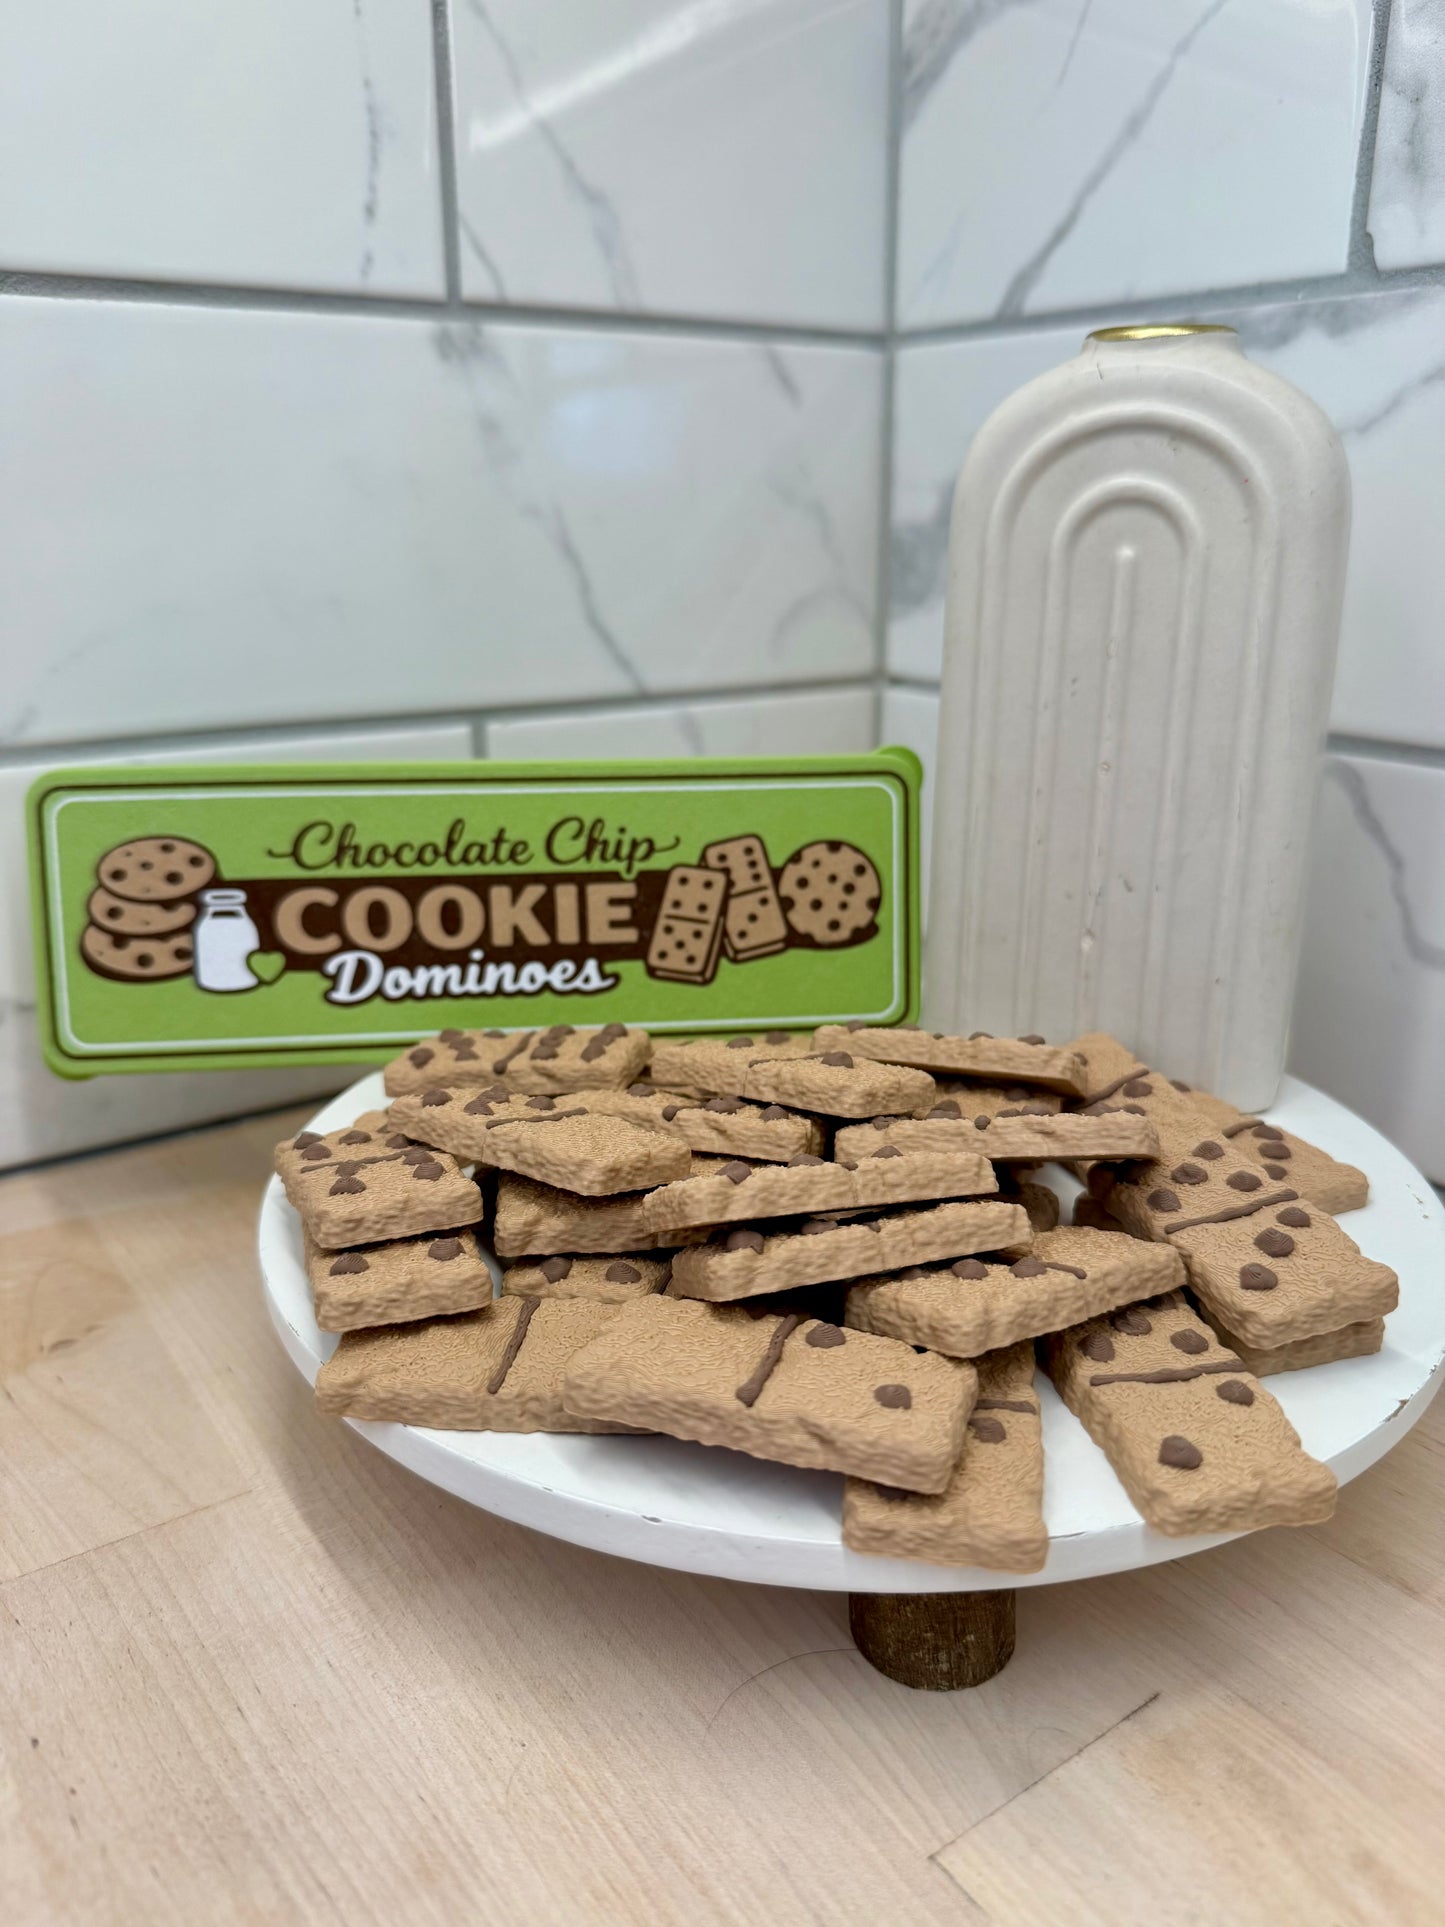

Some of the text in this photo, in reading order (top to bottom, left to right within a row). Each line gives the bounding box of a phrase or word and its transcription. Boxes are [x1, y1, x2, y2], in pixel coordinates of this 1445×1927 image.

[267, 816, 680, 874] Chocolate Chip
[274, 881, 640, 955] COOKIE
[324, 949, 616, 1003] Dominoes
